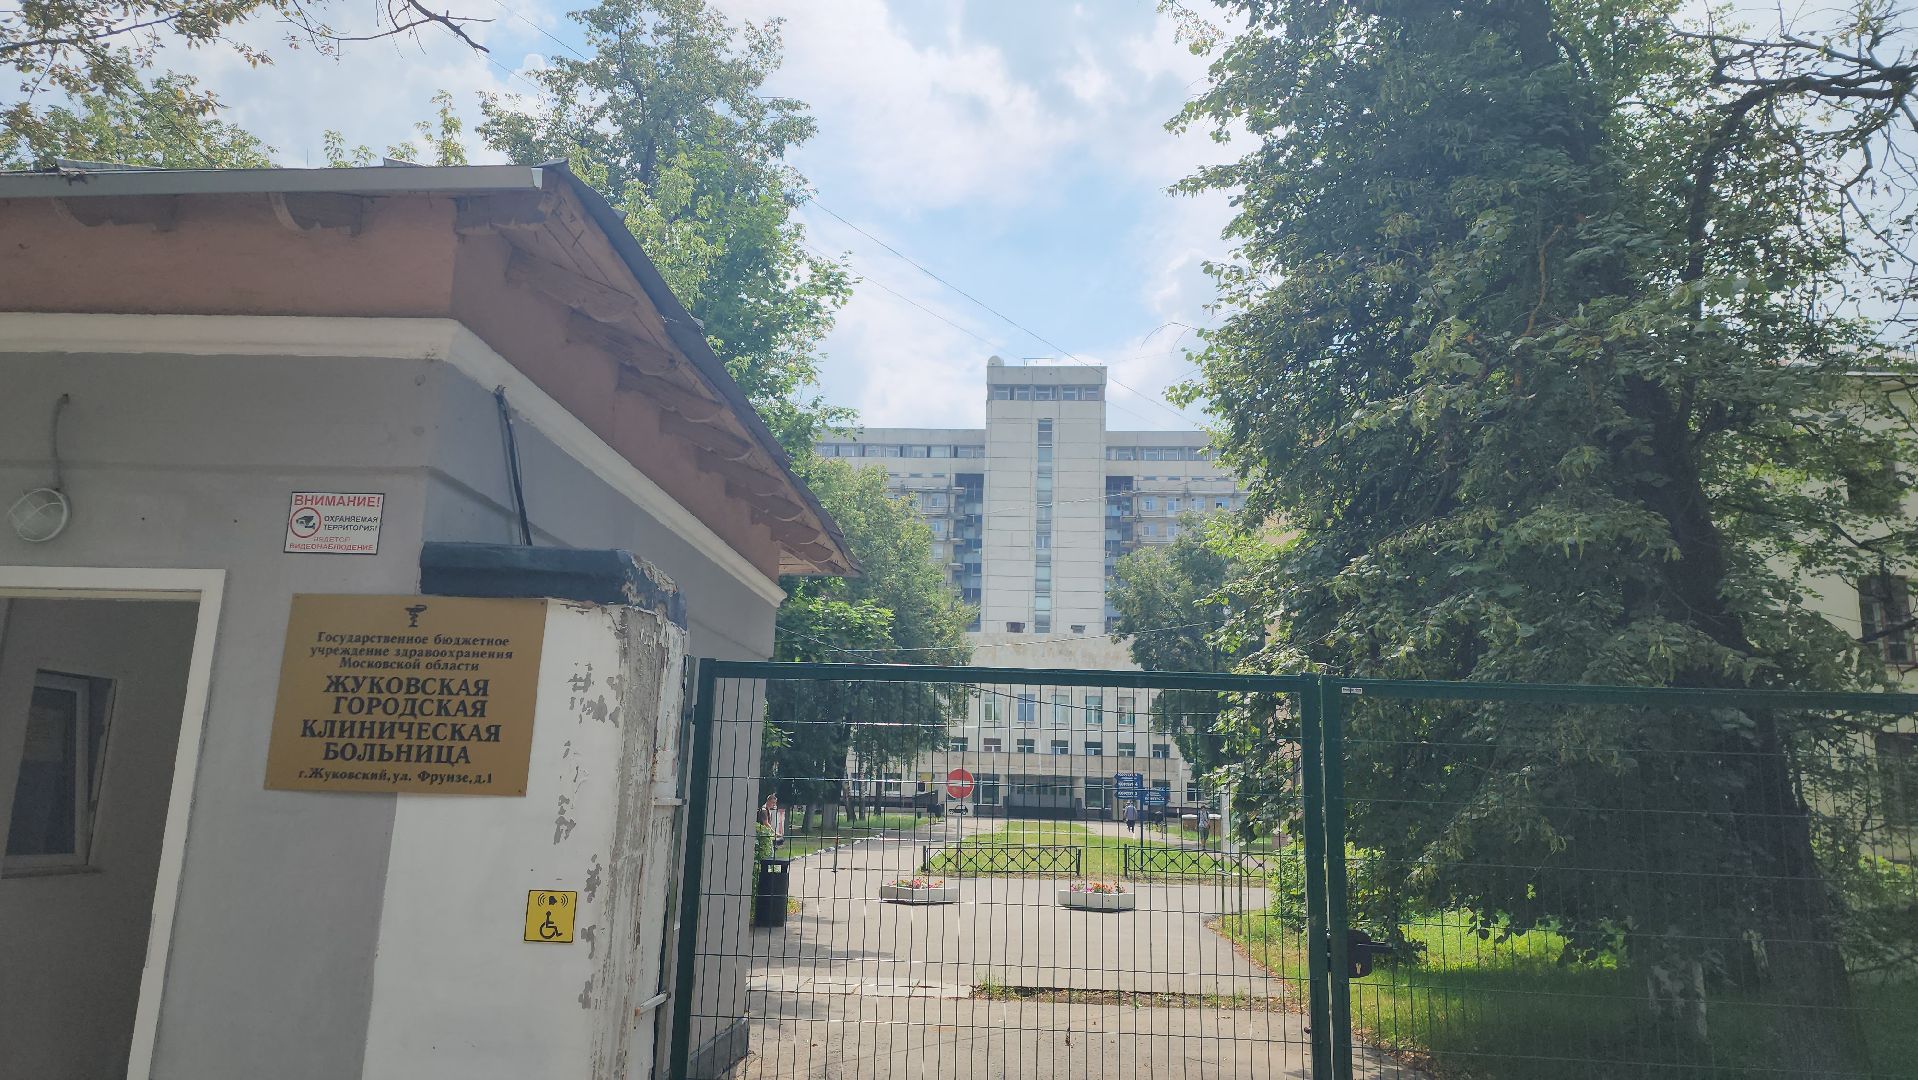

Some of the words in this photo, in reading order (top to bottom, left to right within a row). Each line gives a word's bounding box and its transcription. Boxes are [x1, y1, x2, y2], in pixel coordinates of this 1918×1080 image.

[294, 495, 380, 507] ВНИМАНИЕ!
[324, 515, 378, 523] ОХРАНЯЕМАЯ
[289, 542, 374, 551] ВИДЕОНАБЛЮДЕНИЕ
[317, 631, 428, 646] Государственное
[433, 634, 510, 647] бюджетное
[309, 645, 390, 658] учреждение
[394, 647, 513, 661] здравоохранения
[339, 656, 421, 670] Московской
[425, 660, 480, 672] области
[323, 675, 490, 697] ЖУКОВСКАЯ
[332, 696, 489, 719] ГОРОДСКАЯ
[300, 719, 502, 742] КЛИНИЧЕСКАЯ
[322, 742, 471, 767] БОЛЬНИЦА
